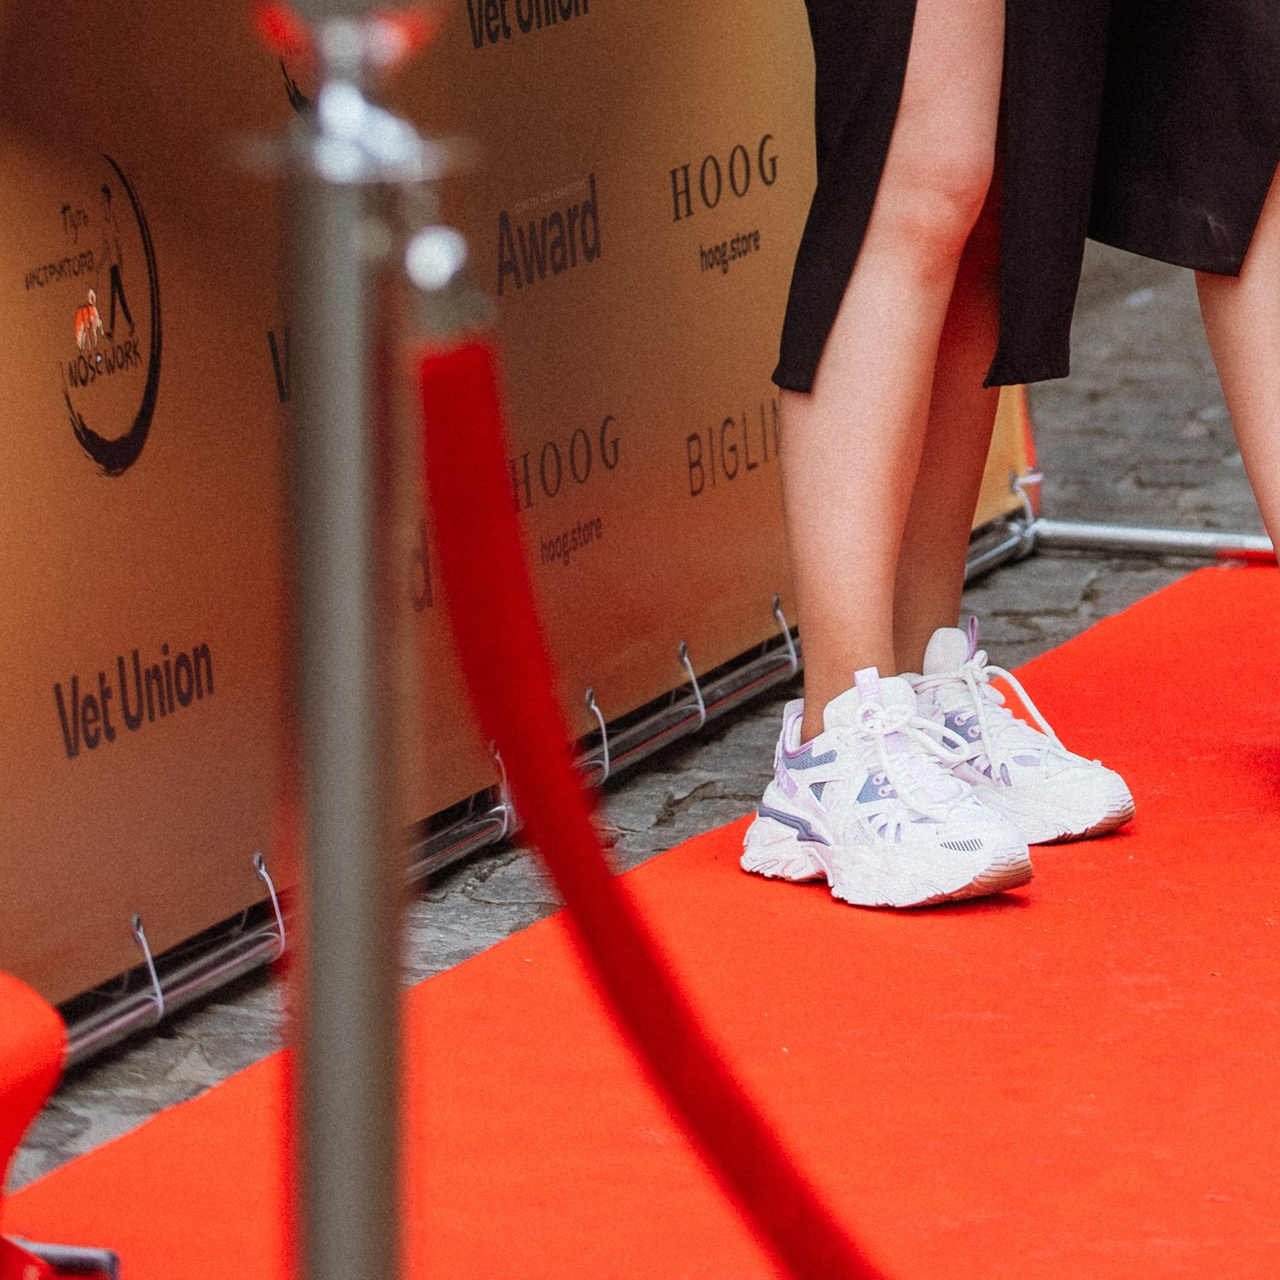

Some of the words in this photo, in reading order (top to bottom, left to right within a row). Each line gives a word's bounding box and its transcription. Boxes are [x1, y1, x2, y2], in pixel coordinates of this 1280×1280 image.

[669, 134, 780, 223] HOOG
[497, 172, 601, 297] Award
[700, 228, 761, 274] hoog.store
[508, 414, 621, 513] HOOG
[686, 398, 779, 497] BIGLI
[540, 516, 603, 567] hoog.store
[54, 672, 117, 760] Vet
[117, 642, 215, 732] Union
